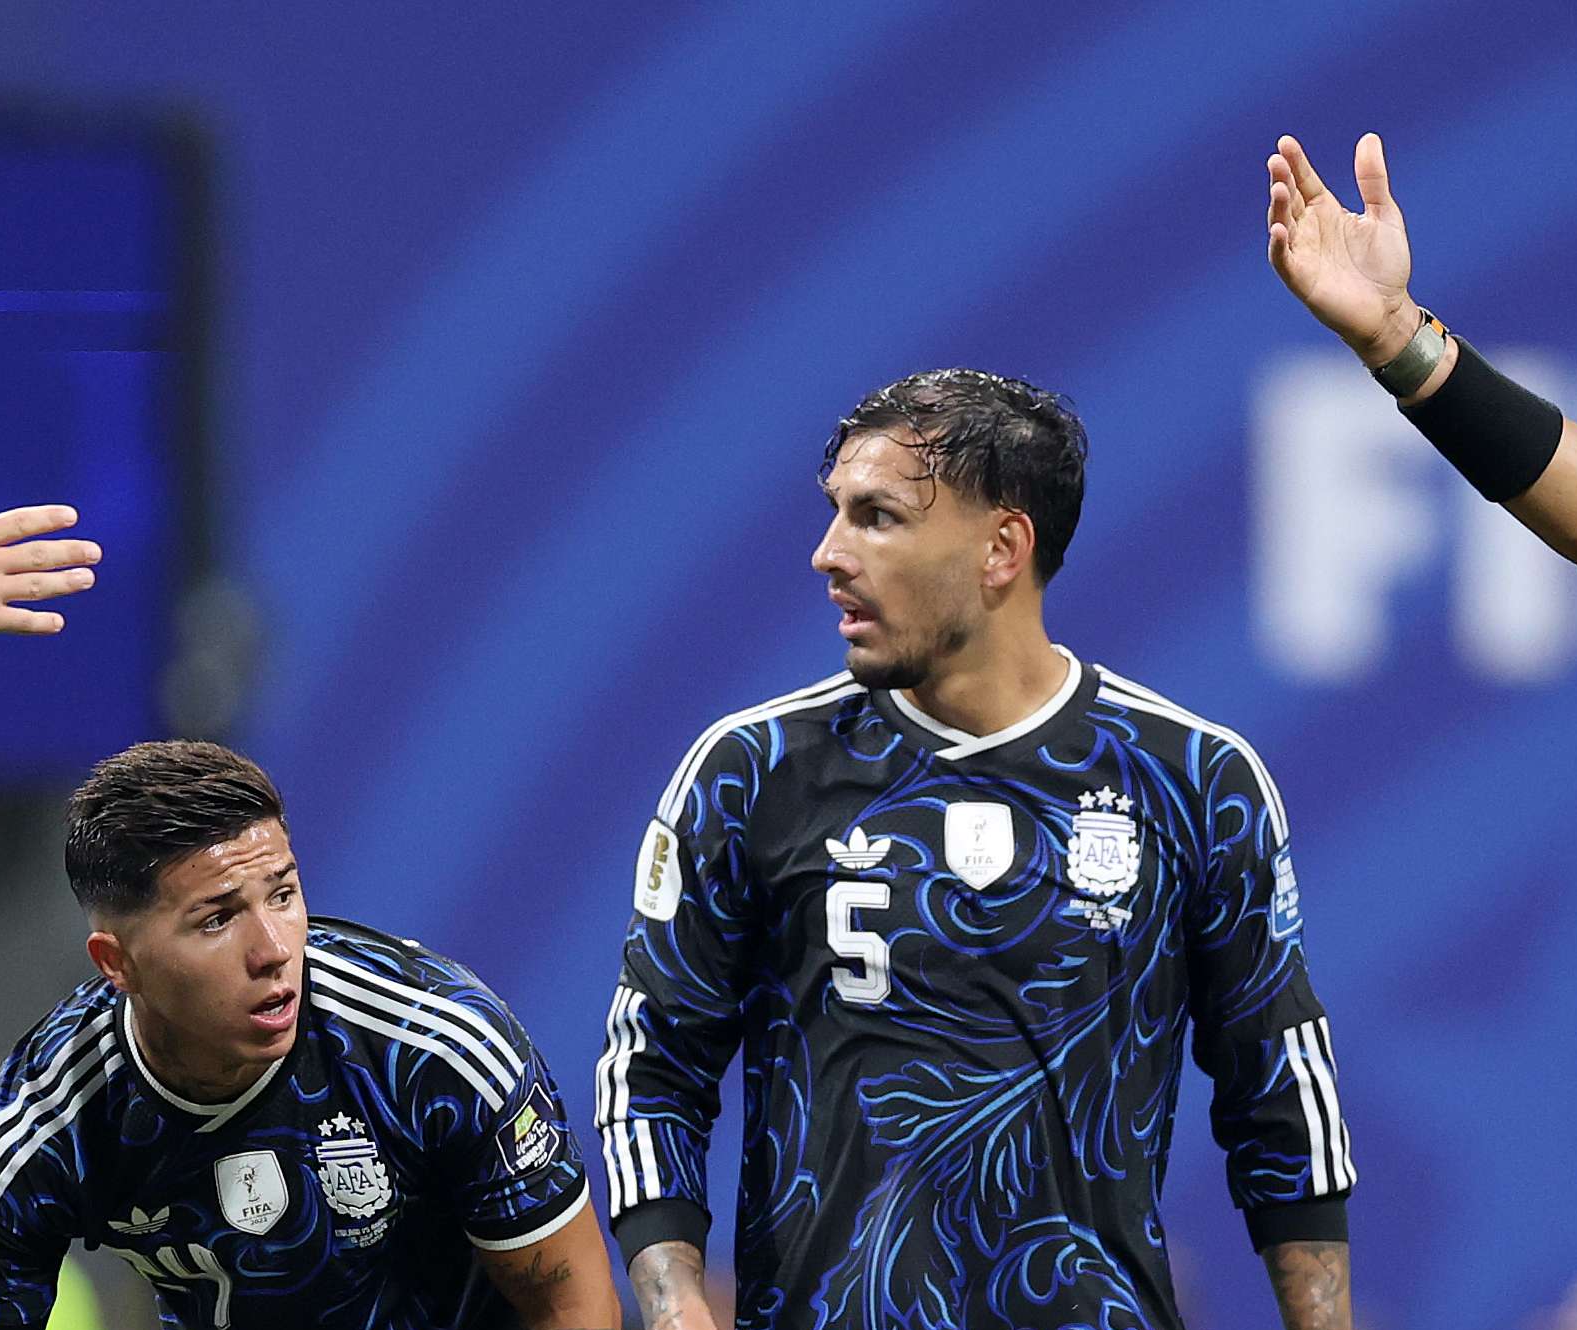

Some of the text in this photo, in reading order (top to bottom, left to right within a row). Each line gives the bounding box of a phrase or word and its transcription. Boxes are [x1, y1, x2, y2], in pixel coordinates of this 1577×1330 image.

[964, 856, 993, 865] FIFA
[1083, 834, 1124, 870] AFA
[825, 881, 891, 1004] 5
[336, 1162, 375, 1195] AFA
[242, 1203, 271, 1217] FIFA
